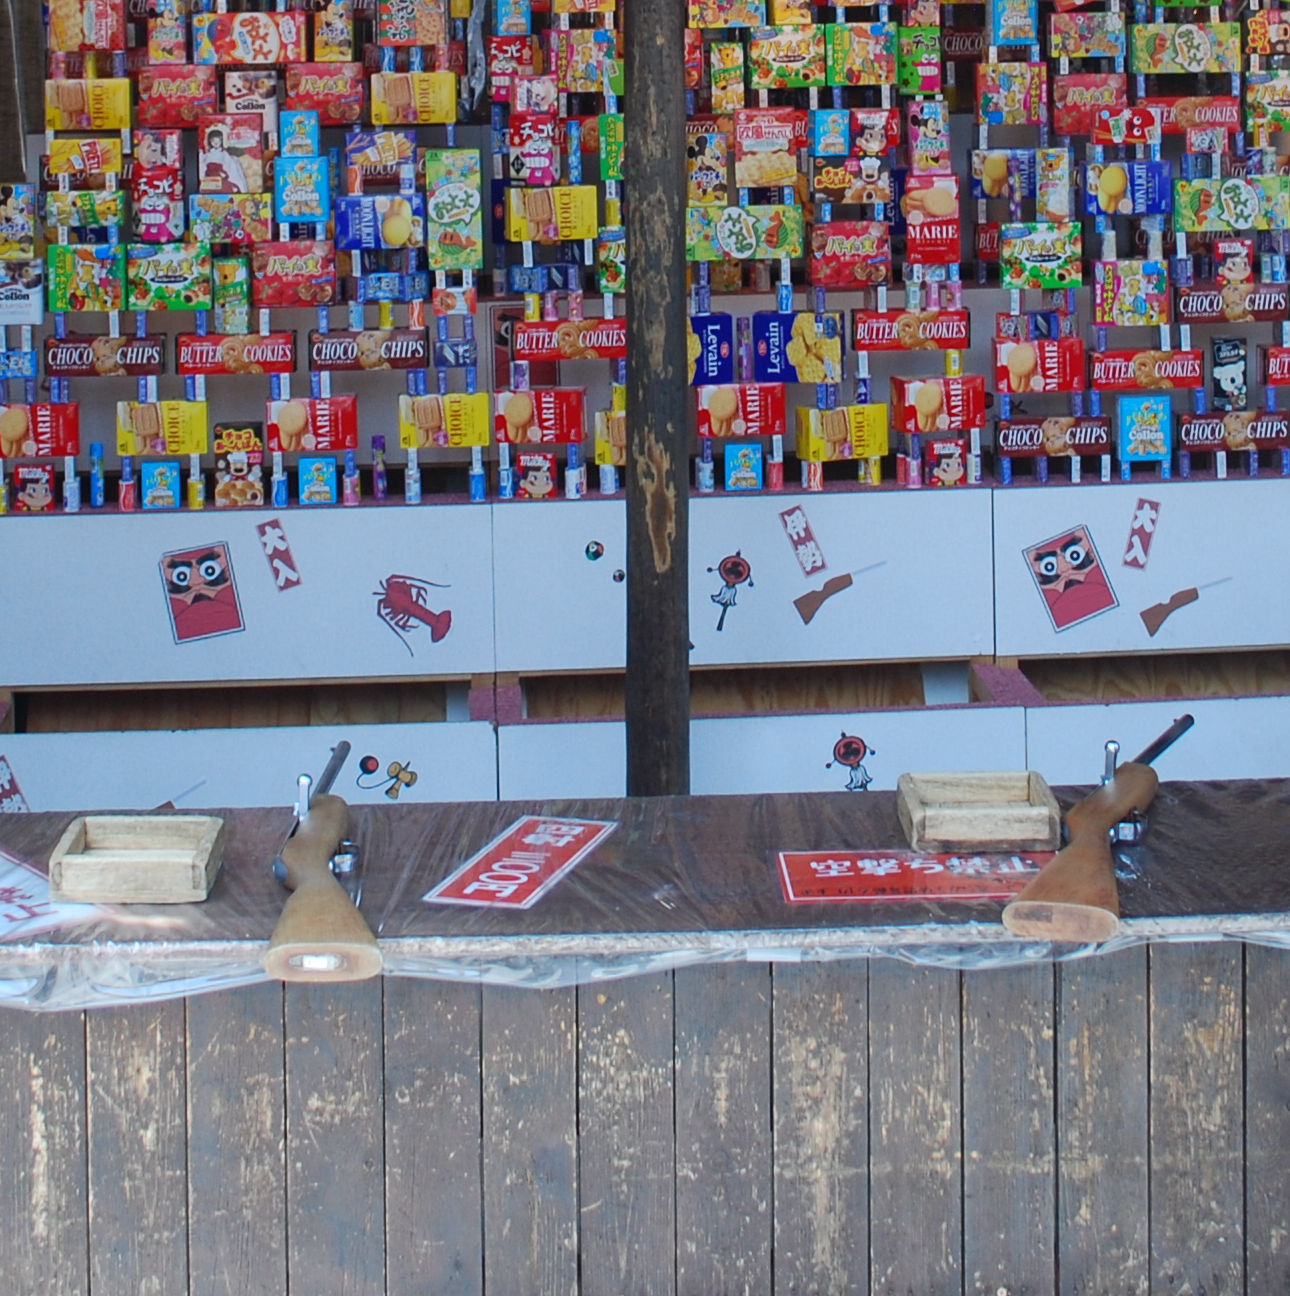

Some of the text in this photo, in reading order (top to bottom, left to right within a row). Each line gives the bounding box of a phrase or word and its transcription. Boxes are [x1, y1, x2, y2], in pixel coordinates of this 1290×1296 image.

[1001, 12, 1032, 25] Collon
[764, 39, 808, 54] パイの実
[912, 34, 940, 51] チョコ
[944, 36, 983, 51] CHOCO
[152, 79, 202, 96] パイの実
[299, 77, 350, 94] パイの実
[91, 84, 104, 128] CHOICE
[235, 101, 266, 111] Collon
[419, 75, 431, 122] CHOICE
[1195, 108, 1238, 123] COOKIES
[520, 121, 555, 141] チョコビ
[737, 125, 795, 139] 欧風せんべい
[361, 163, 397, 177] HOCO
[138, 177, 174, 197] チョコビ
[282, 190, 320, 202] Collon
[1134, 164, 1147, 214] MOONLIGHT
[362, 197, 373, 248] MOONLIGHT
[561, 189, 572, 238] CHOICE
[907, 224, 957, 239] MARIE
[826, 237, 877, 254] パイの実
[979, 234, 998, 250] BUT
[1017, 239, 1068, 255] パイの実
[143, 258, 193, 275] パイの実
[268, 256, 321, 274] パイの実
[56, 248, 66, 308] たべっ子どうぶつ
[1180, 293, 1286, 312] CHOCO CHIPS
[517, 330, 626, 348] BUTTER COOKIES
[857, 322, 966, 339] BUTTER COOKIES
[48, 347, 159, 364] CHOCO CHIPS
[181, 345, 291, 362] BUTTER COOKIES
[313, 341, 424, 360] CHOCO CHIPS
[707, 324, 721, 377] Levain
[766, 321, 781, 374] Levain
[1045, 342, 1058, 391] MARIE
[1093, 360, 1200, 379] BUTTER COOKIES
[746, 385, 760, 435] MARIE
[949, 379, 962, 429] MARIE
[317, 399, 330, 450] MARIE
[450, 396, 462, 446] CHOICE
[541, 392, 556, 442] MARIE
[37, 405, 51, 456] MARIE
[167, 404, 180, 453] CHOICE
[853, 407, 866, 457] CHOICE
[999, 426, 1108, 447] CHOCO CHIPS
[1129, 430, 1165, 441] Collon
[1182, 420, 1288, 440] CHOCO CHIPS
[519, 454, 551, 469] Milky
[784, 509, 823, 572] 伊勢
[1125, 502, 1157, 565] 大入
[261, 525, 299, 587] 大入
[810, 855, 1040, 876] 空撃ち禁止
